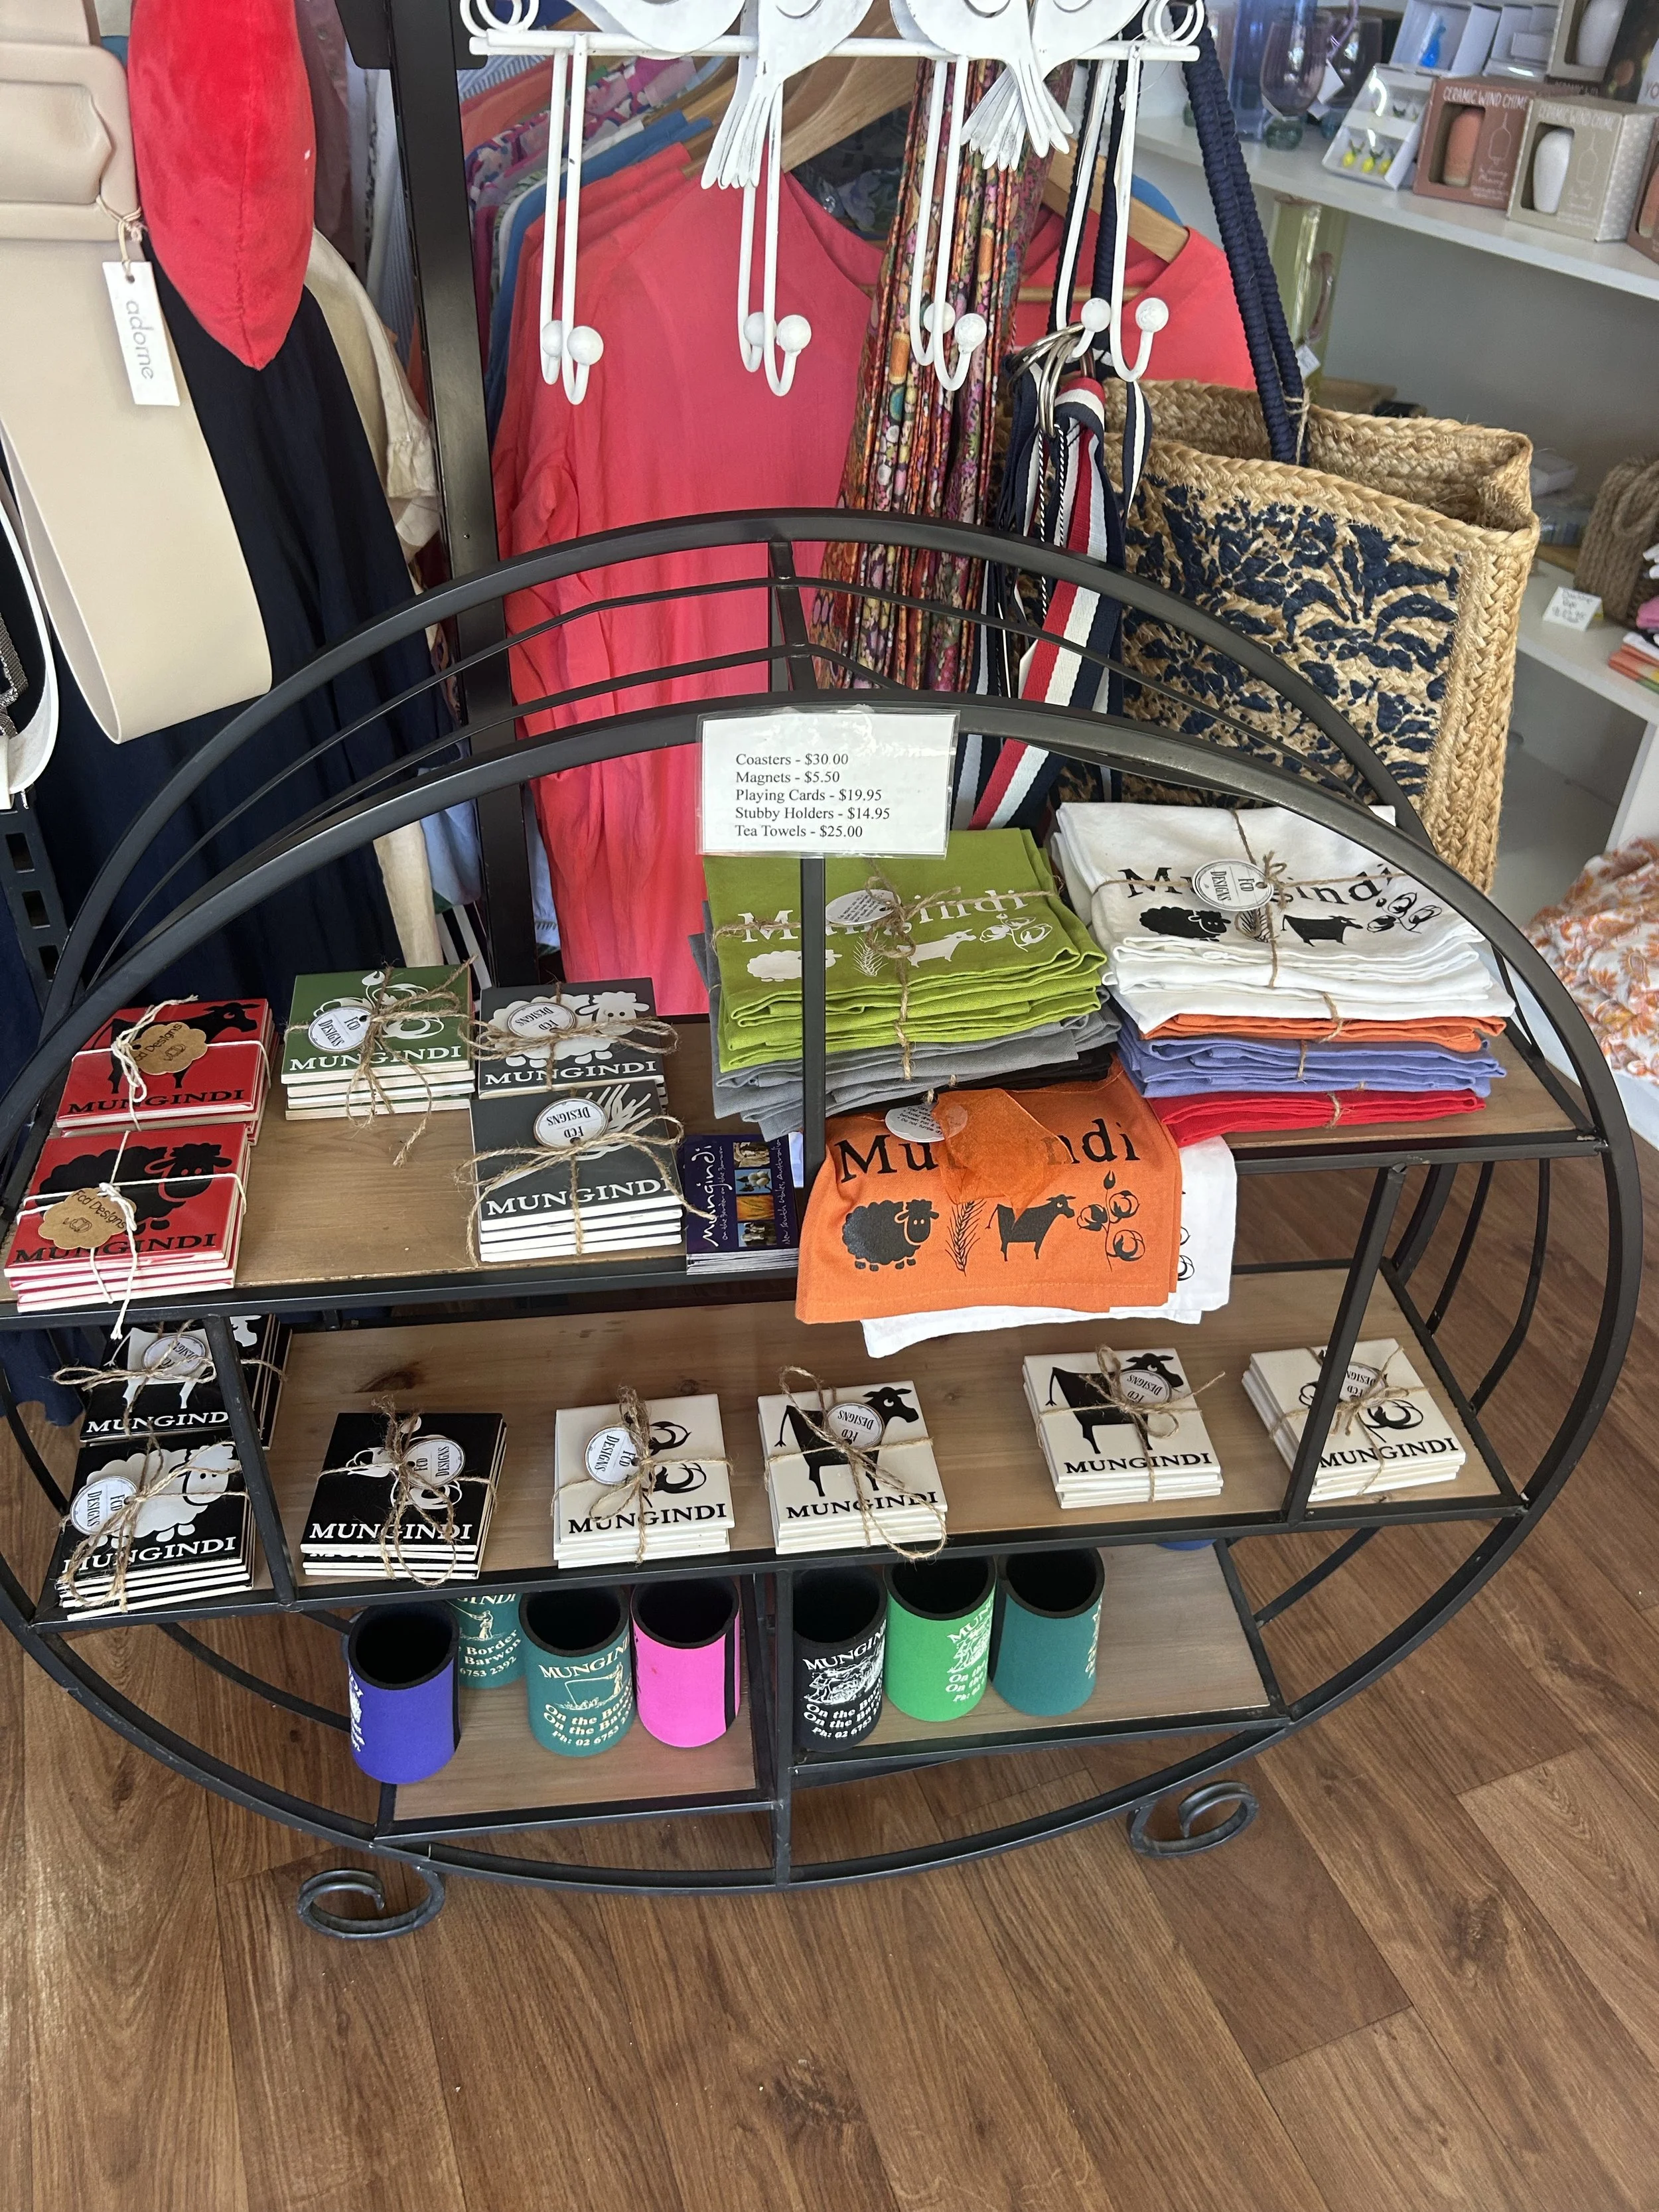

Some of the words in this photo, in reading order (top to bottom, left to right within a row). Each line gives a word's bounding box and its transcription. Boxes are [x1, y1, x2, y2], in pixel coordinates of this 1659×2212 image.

[1478, 90, 1502, 107] WIND
[736, 753, 792, 765] Coasters
[804, 753, 849, 766] $30.00
[735, 771, 791, 786] Magnets
[804, 771, 840, 783] $5.50
[736, 788, 785, 804] Playing
[789, 788, 826, 801] Cards
[839, 788, 882, 802] $19.95
[735, 806, 780, 822] Stubby
[784, 807, 834, 819] Holders
[847, 806, 891, 820] $14.95
[735, 825, 758, 837] Tea
[761, 825, 806, 837] Towels
[820, 825, 863, 838] $25.00
[1210, 871, 1232, 902] DESIGNS
[1238, 878, 1254, 893] FCD
[737, 888, 1029, 944] Mindi
[343, 1016, 361, 1031] FCD
[514, 1006, 555, 1027] DESIGNS
[538, 1019, 559, 1031] FCD
[318, 1019, 346, 1048] DESIGNS
[289, 1045, 462, 1071] MUNGINDI
[485, 1061, 658, 1086] MUNGINDI
[68, 1088, 245, 1114] MUNGINDI
[546, 1106, 591, 1127] DESIGNS
[563, 1126, 585, 1139] FCD
[770, 1139, 784, 1180] Australia
[691, 1145, 733, 1247] Mungindi
[777, 1202, 790, 1228] South
[781, 1229, 791, 1245] New
[1127, 1374, 1163, 1396] DESIGNS
[1346, 1370, 1376, 1386] DESIGN
[1127, 1390, 1145, 1404] FCD
[86, 1412, 229, 1433] MUNGIND
[837, 1410, 875, 1430] DESIGNS
[841, 1428, 859, 1442] FCD
[435, 1445, 450, 1477] DESIGNS
[594, 1435, 620, 1472] DESIGNS
[618, 1450, 636, 1467] FCD
[1063, 1453, 1213, 1473] MUNGINDI
[1320, 1438, 1459, 1468] MUNGINDI
[415, 1457, 429, 1471] FCD
[86, 1490, 102, 1527] DESIGNS
[110, 1494, 125, 1511] FCD
[786, 1492, 939, 1518] MUNGINDI
[568, 1503, 727, 1534] MUNGINDI
[464, 1638, 521, 1665] Barwon
[467, 1629, 517, 1656] Border
[459, 1667, 487, 1677] 6753
[490, 1656, 517, 1675] 2392
[946, 1684, 966, 1692] On
[949, 1674, 969, 1683] On
[545, 1704, 567, 1722] On
[571, 1717, 597, 1726] the
[804, 1712, 825, 1726] On
[830, 1720, 853, 1728] the
[806, 1703, 828, 1718] On
[833, 1709, 856, 1719] the
[543, 1712, 565, 1731] On
[569, 1726, 595, 1735] the
[812, 1727, 832, 1738] Ph:
[834, 1730, 848, 1739] 02
[850, 1716, 872, 1735] 6753
[551, 1730, 573, 1745] Ph:
[593, 1725, 619, 1745] 6753
